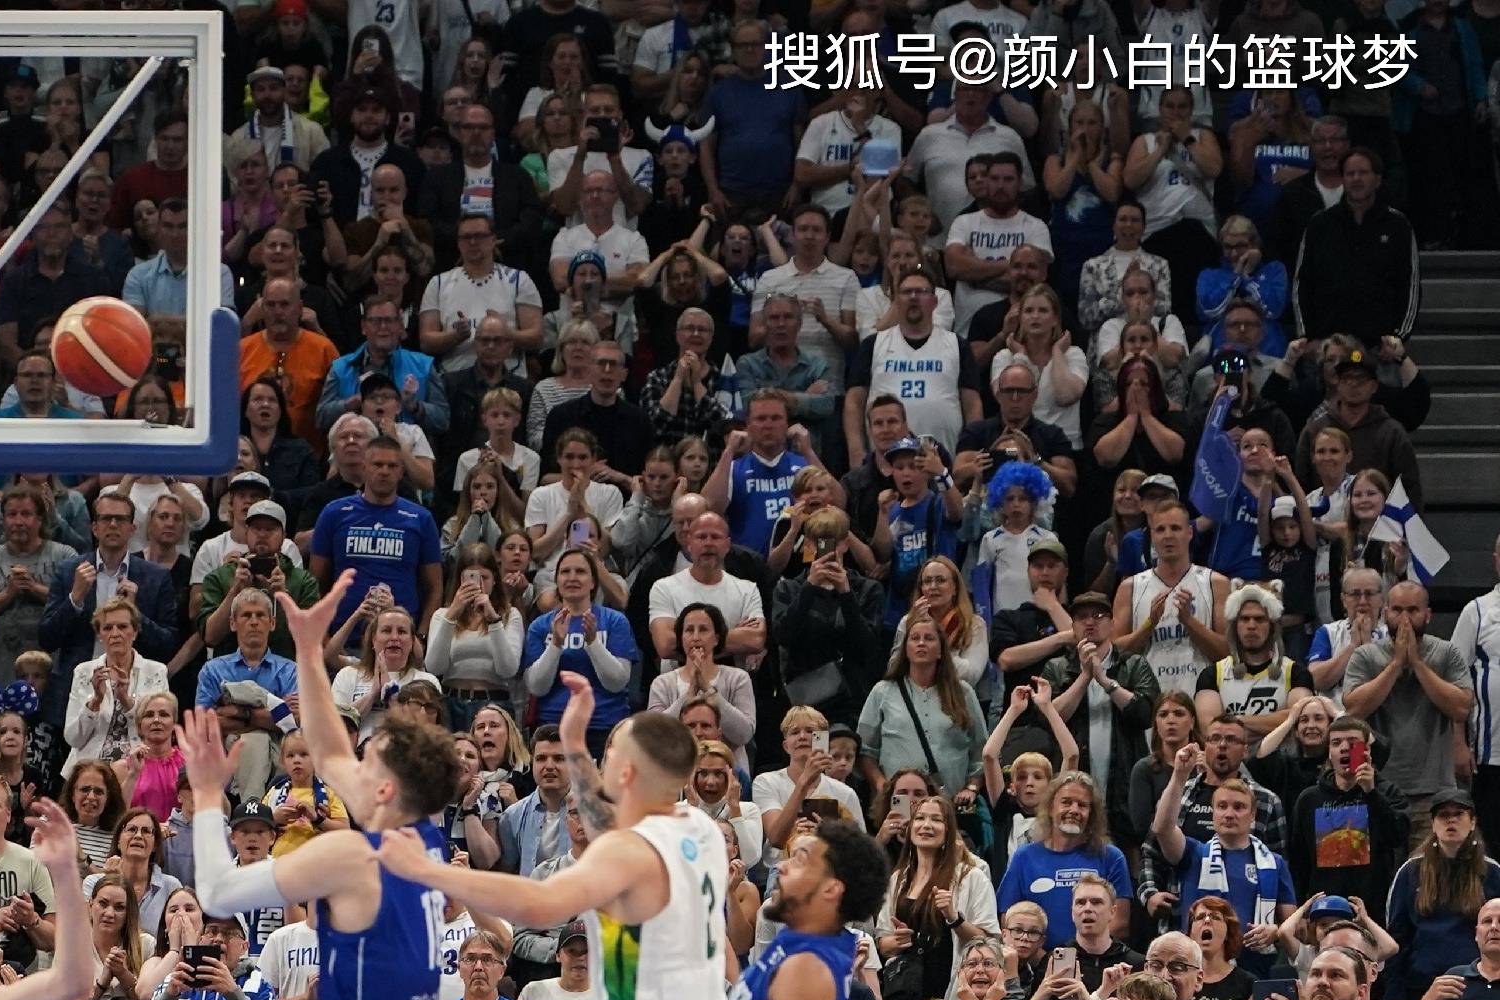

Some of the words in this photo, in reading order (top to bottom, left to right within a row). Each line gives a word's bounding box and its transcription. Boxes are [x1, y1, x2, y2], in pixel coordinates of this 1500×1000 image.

[970, 231, 1025, 249] FINLAND
[884, 359, 943, 373] FINLAND
[900, 380, 926, 398] 23
[345, 536, 404, 557] FINLAND
